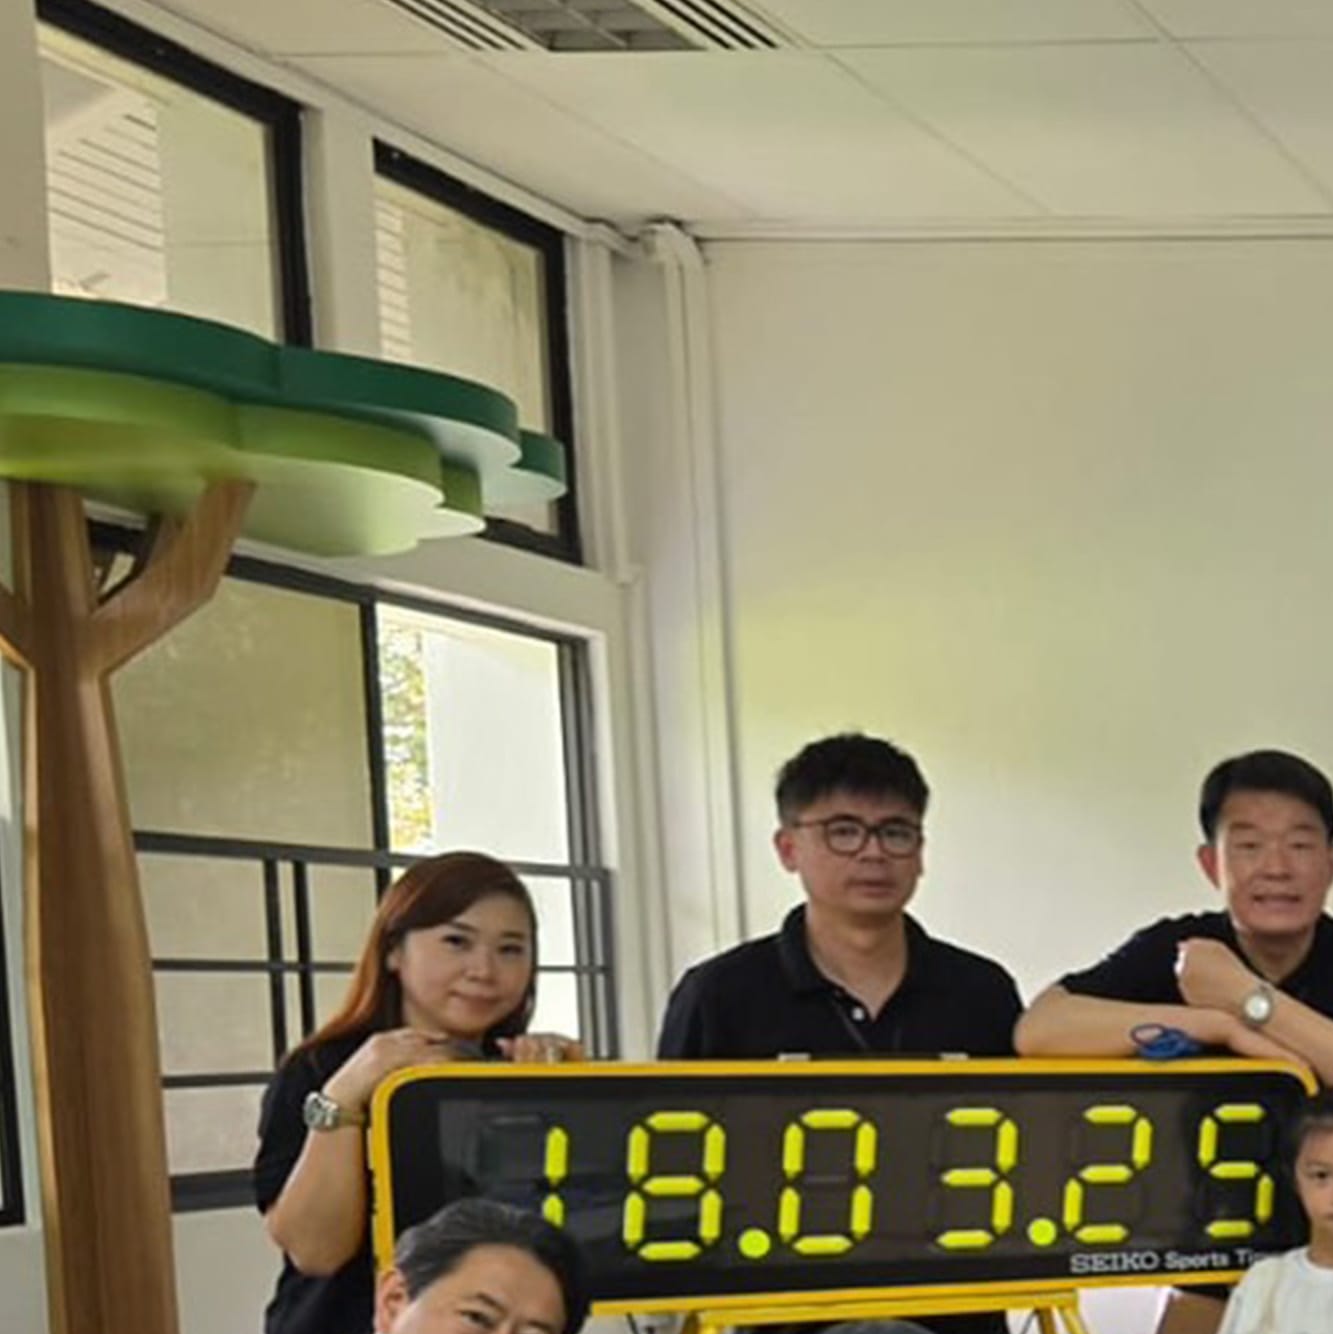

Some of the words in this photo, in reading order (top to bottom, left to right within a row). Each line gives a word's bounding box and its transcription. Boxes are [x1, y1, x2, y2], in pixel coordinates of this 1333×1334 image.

[543, 1103, 1275, 1260] 18.03.25
[1069, 1251, 1160, 1274] SEIKO
[1163, 1250, 1229, 1271] Sports
